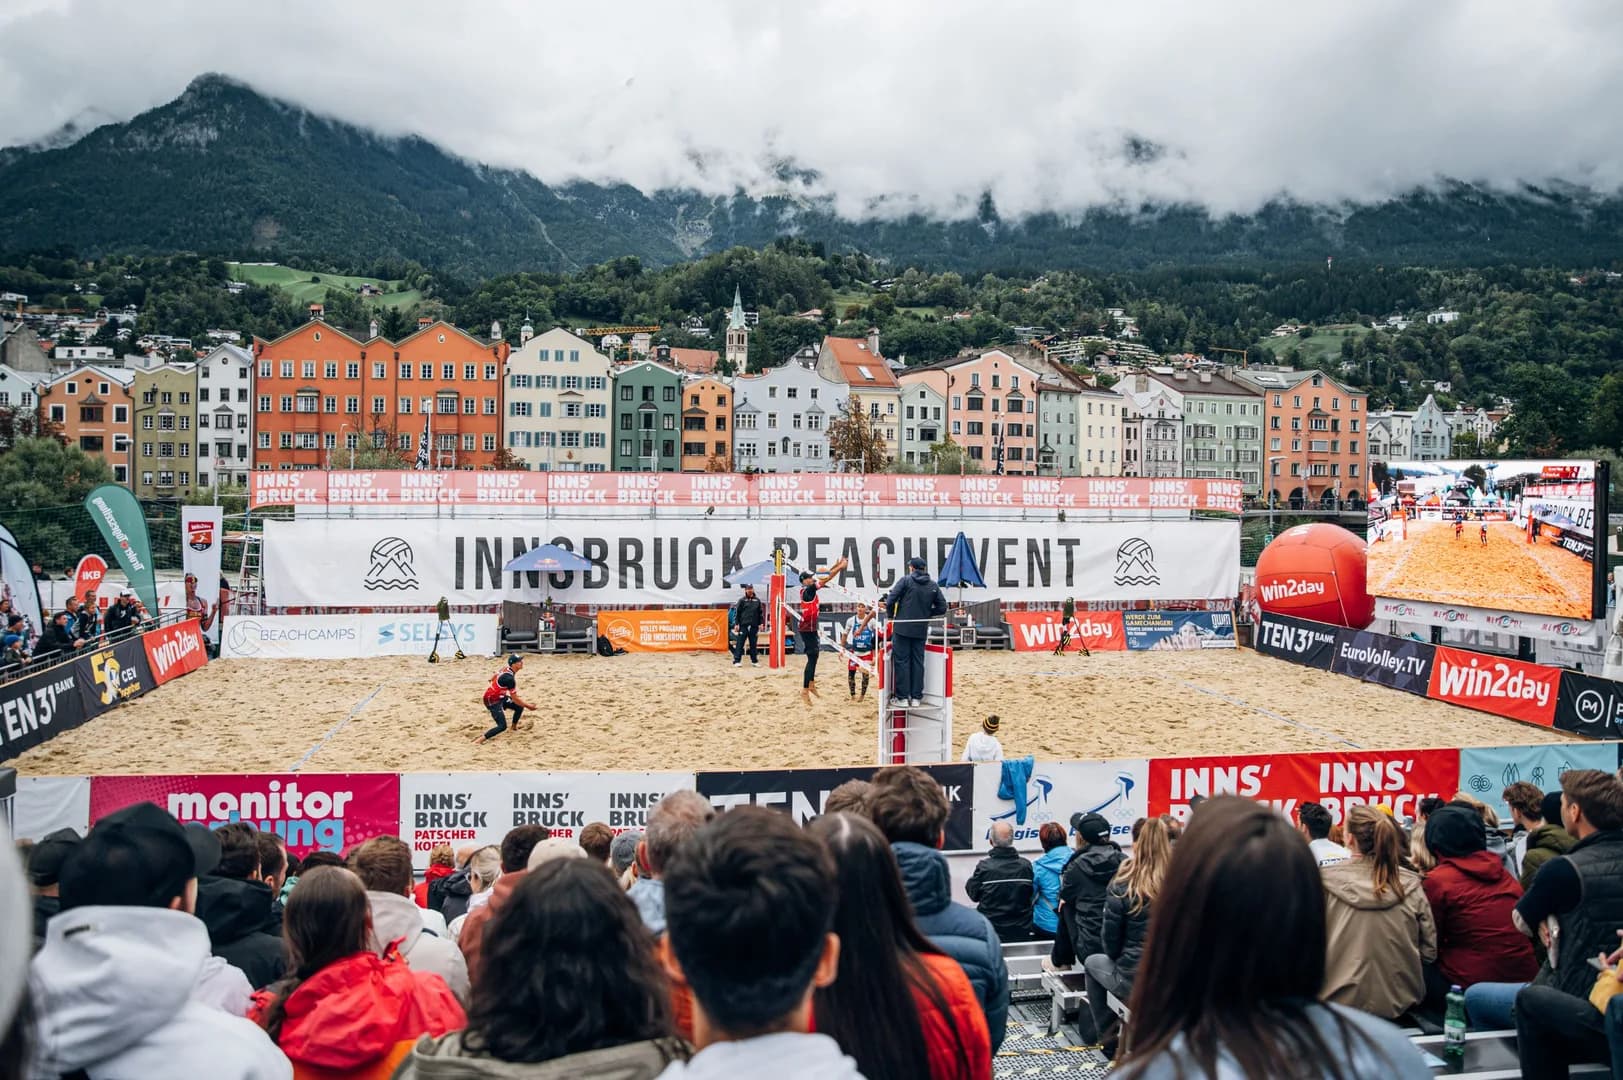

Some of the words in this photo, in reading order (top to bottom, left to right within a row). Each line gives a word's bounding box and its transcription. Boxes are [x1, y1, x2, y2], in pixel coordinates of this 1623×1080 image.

[256, 474, 304, 488] INNS'
[328, 473, 376, 488] INNS'
[401, 473, 448, 488] INNS'
[477, 474, 524, 488] INNS'
[549, 474, 594, 488] INNS'
[618, 475, 662, 488] INNS'
[691, 476, 736, 490] INNS'
[760, 476, 802, 490] INNS'
[825, 476, 868, 490] INNS'
[896, 478, 938, 491] INNS'
[960, 478, 1002, 491] INNS'
[1022, 480, 1064, 493] INNS'
[1088, 480, 1128, 494] INNS'
[1150, 480, 1188, 494] INNS'
[256, 488, 317, 504] BRUCK
[328, 488, 388, 502] BRUCK
[401, 488, 460, 502] BRUCK
[477, 489, 536, 503] BRUCK
[549, 490, 607, 503] BRUCK
[618, 490, 676, 504] BRUCK
[691, 490, 748, 504] BRUCK
[759, 490, 815, 504] BRUCK
[825, 490, 880, 504] BRUCK
[896, 491, 950, 504] BRUCK
[960, 491, 1014, 504] BRUCK
[1022, 494, 1076, 506] BRUCK
[1088, 494, 1140, 507] BRUCK
[1150, 494, 1198, 507] BRUCK
[1207, 495, 1242, 511] BRUC
[455, 536, 748, 590] INNSBRUCK
[82, 570, 101, 580] IKB
[1260, 578, 1324, 602] win2day
[260, 626, 356, 642] BEACHCAMPS
[400, 623, 476, 642] SELSYS
[1020, 616, 1112, 647] win2day
[1314, 632, 1334, 644] BANK
[152, 630, 200, 676] win2day
[1340, 642, 1426, 676] EuroVolley.TV
[121, 666, 137, 682] CEV
[54, 676, 75, 695] BANK
[1439, 658, 1550, 706] win2day
[1170, 764, 1271, 800] INNS'
[1319, 760, 1414, 794] INNS'
[167, 780, 353, 820] monitor
[415, 794, 472, 810] INNS'
[513, 792, 570, 808] INNS'
[415, 812, 488, 828] BRUCK
[513, 811, 584, 826] BRUCK
[610, 811, 649, 826] BRU
[414, 830, 476, 840] PATSCHER
